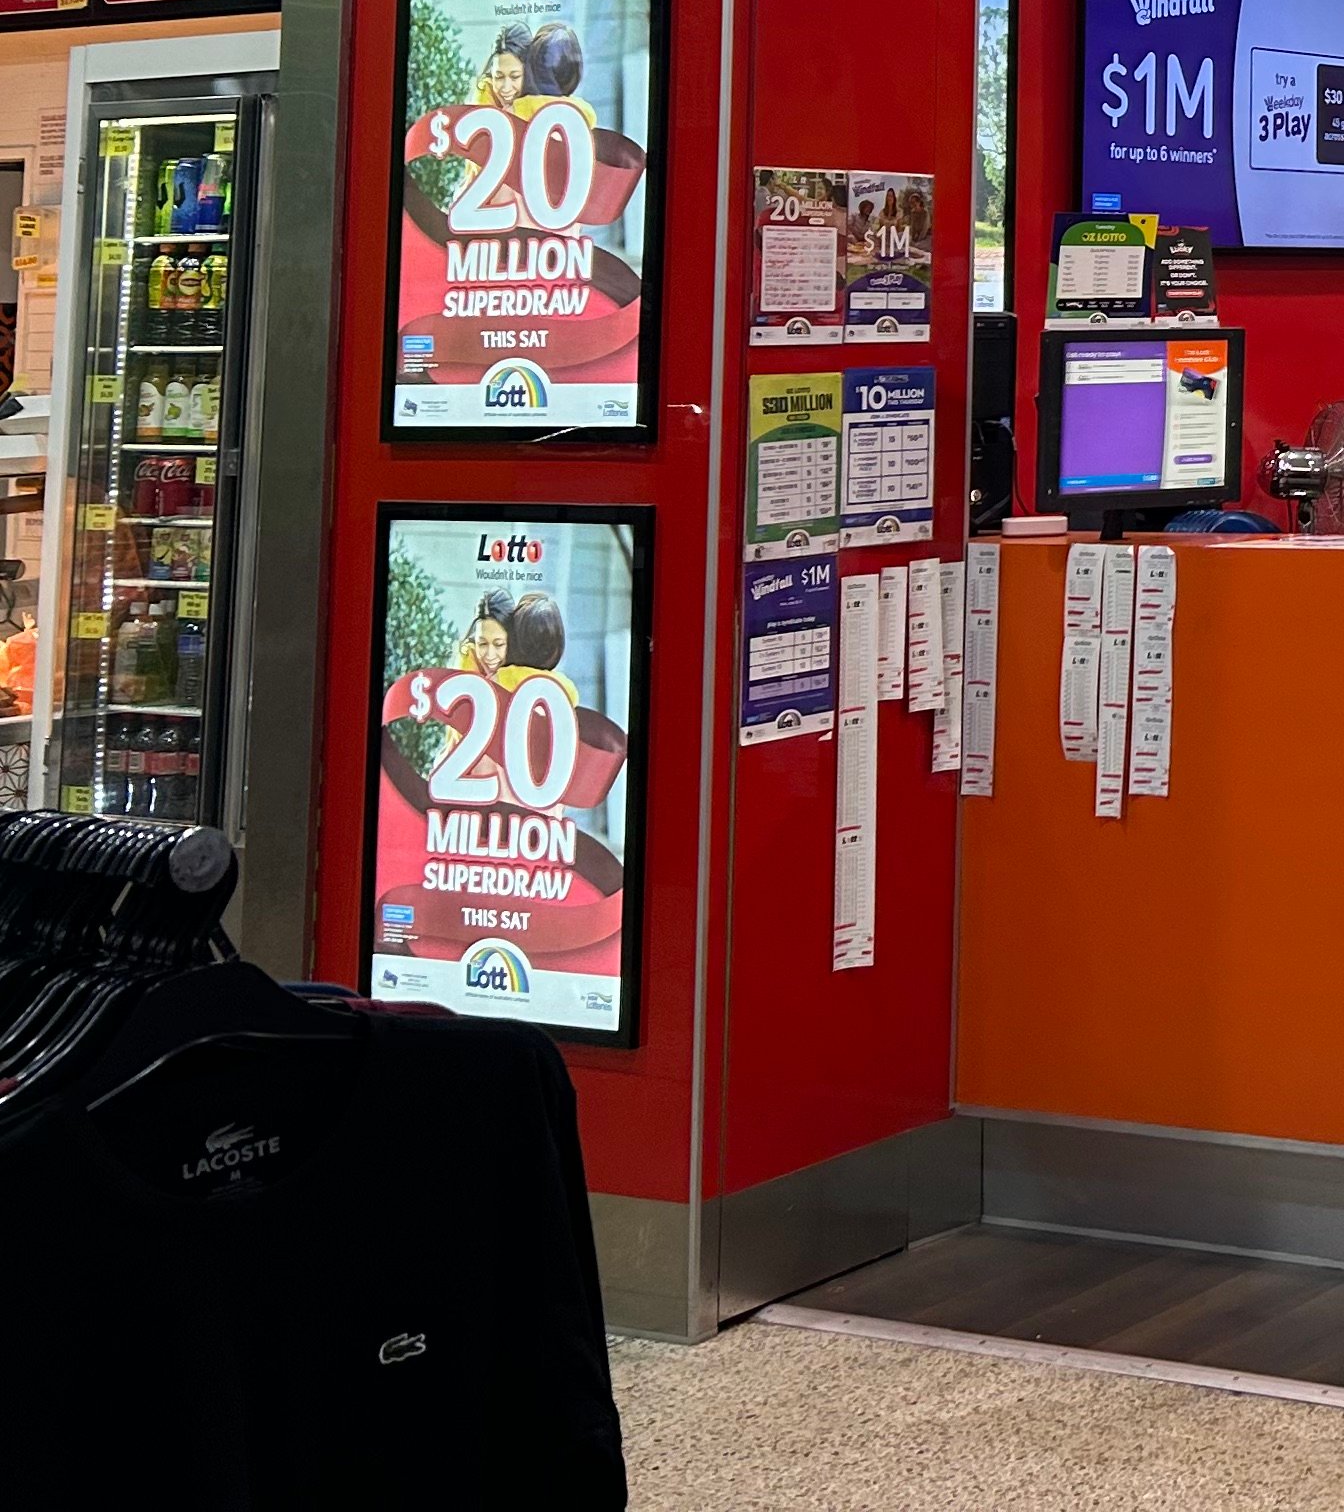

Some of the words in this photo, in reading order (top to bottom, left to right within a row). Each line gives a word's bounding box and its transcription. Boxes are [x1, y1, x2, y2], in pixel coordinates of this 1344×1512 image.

[1275, 73, 1288, 88] try
[1290, 76, 1296, 86] a
[1102, 52, 1214, 139] $1M
[1324, 88, 1343, 104] $30
[1259, 115, 1269, 142] 3
[1273, 111, 1311, 143] Play
[1110, 144, 1127, 159] for
[1129, 148, 1143, 163] up
[1146, 146, 1157, 160] to
[1160, 146, 1167, 162] 6
[864, 225, 910, 258] $1M
[1097, 232, 1127, 242] LOTTO
[447, 239, 594, 281] MILLION
[442, 287, 589, 318] SUPERDRAW
[480, 331, 516, 348] THIS
[519, 330, 549, 348] SAT
[485, 384, 526, 408] Lott
[790, 393, 833, 413] MILLION
[888, 388, 925, 398] MILLION
[477, 534, 543, 563] Lotto
[801, 564, 830, 585] $1M
[427, 808, 576, 864] MILLION
[422, 861, 572, 901] SUPERDRAW
[461, 907, 497, 928] THIS
[500, 911, 531, 931] SAT
[466, 962, 509, 991] Lott
[182, 1135, 280, 1181] LACOSTE
[230, 1169, 242, 1182] M
